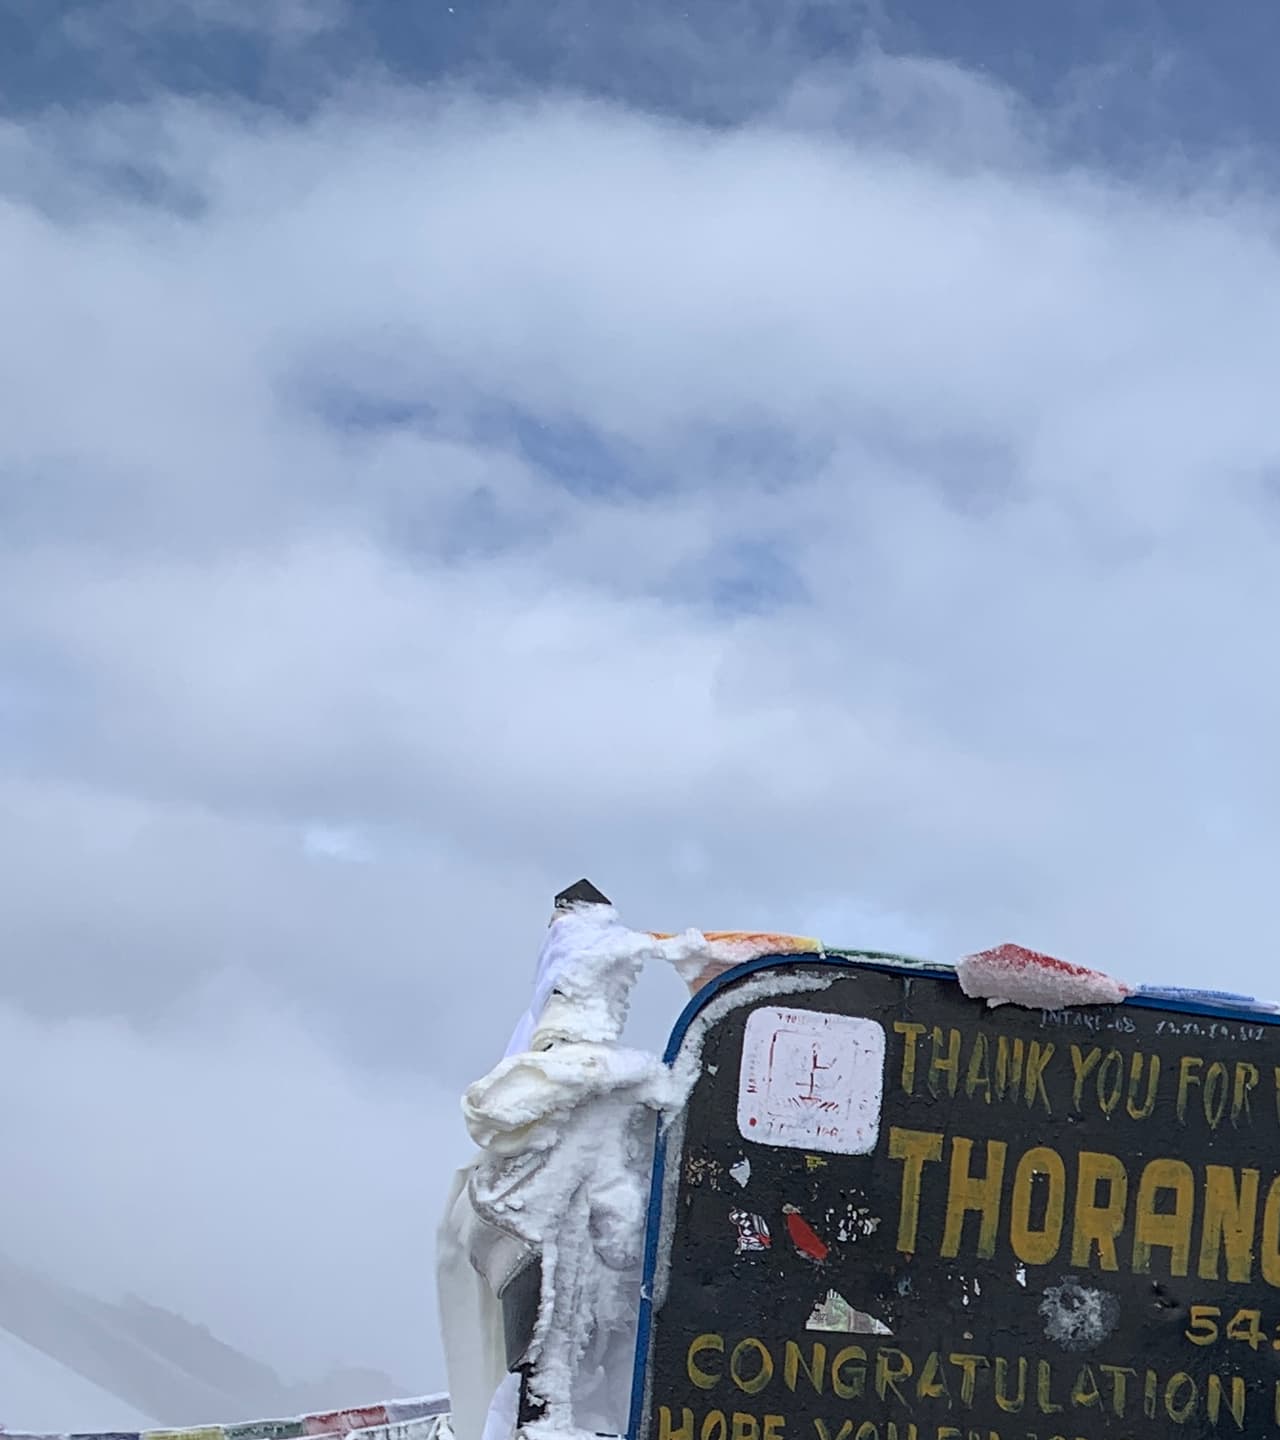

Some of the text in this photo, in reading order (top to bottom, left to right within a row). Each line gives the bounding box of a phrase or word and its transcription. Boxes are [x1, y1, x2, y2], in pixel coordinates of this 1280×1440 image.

[894, 1021, 1052, 1115] THANK
[1070, 1043, 1161, 1121] YOU
[1177, 1055, 1259, 1130] FOR
[687, 1333, 1247, 1432] CONGRATULATION
